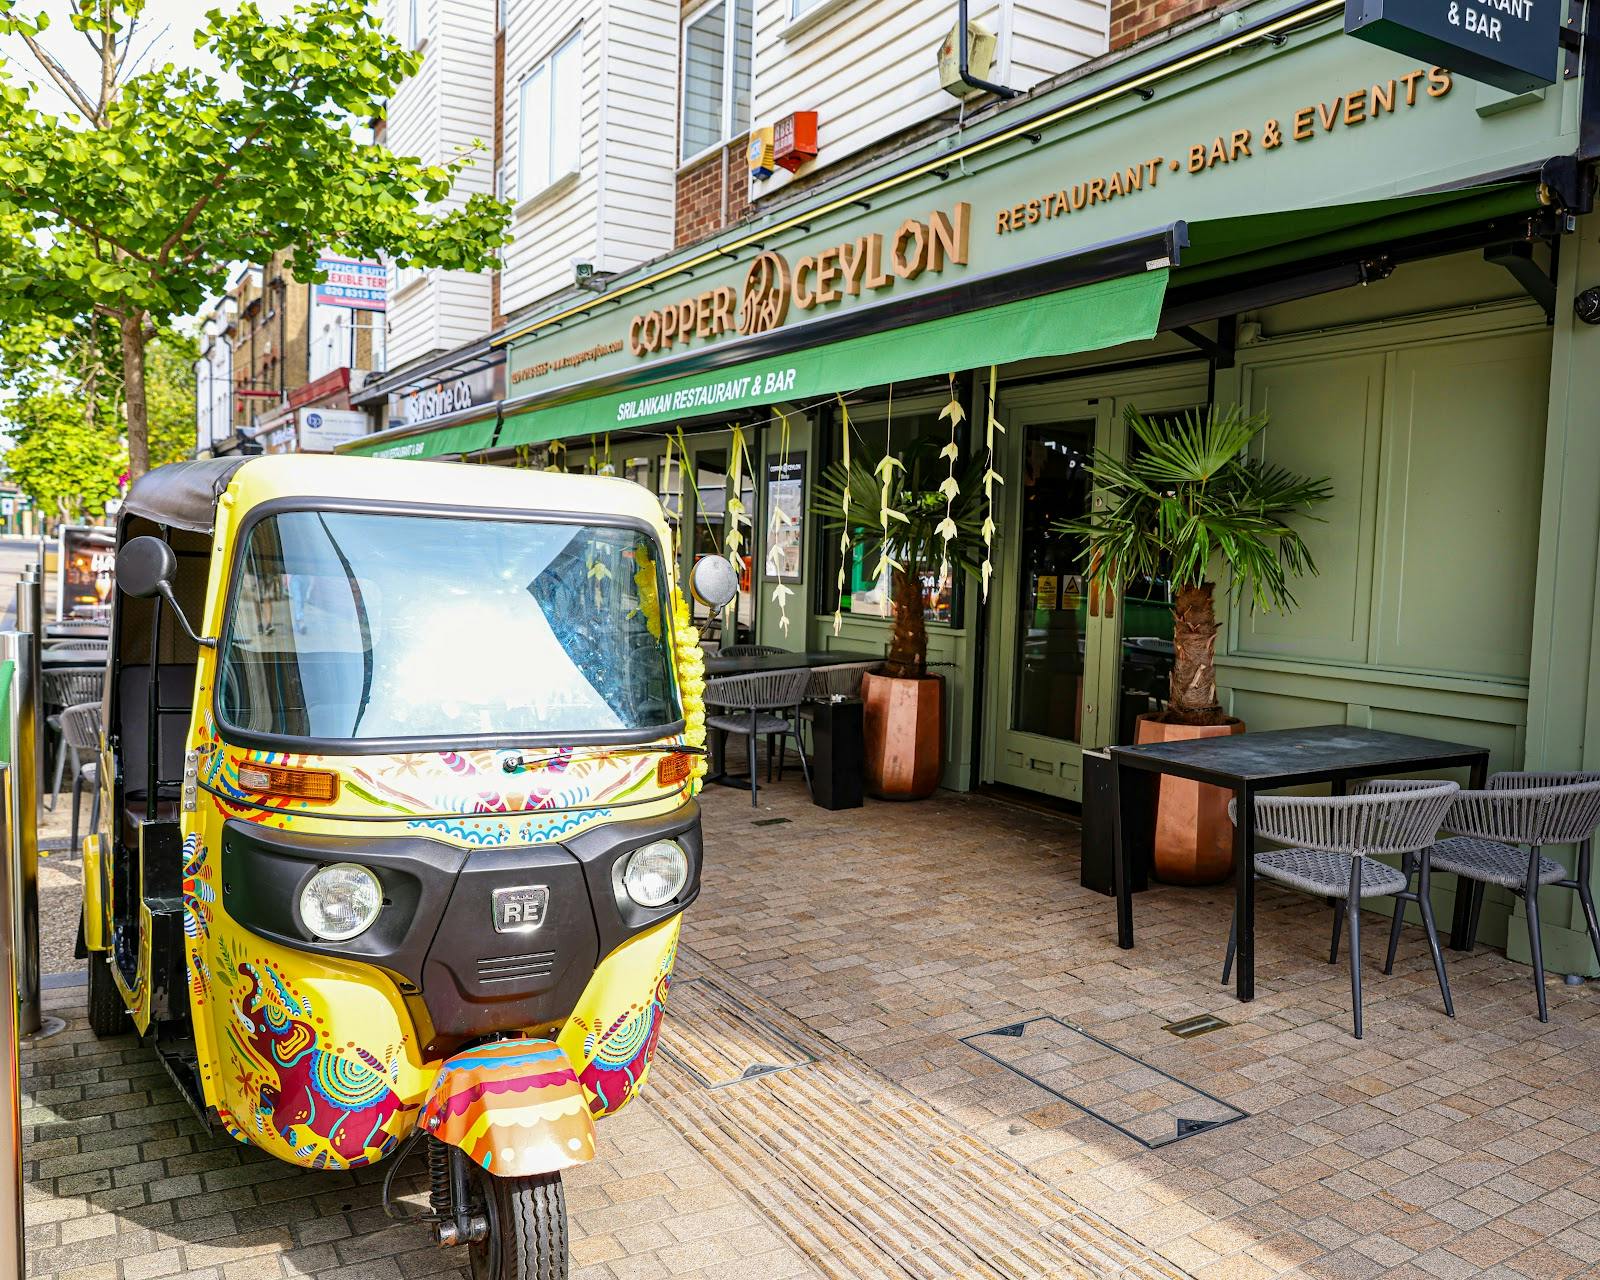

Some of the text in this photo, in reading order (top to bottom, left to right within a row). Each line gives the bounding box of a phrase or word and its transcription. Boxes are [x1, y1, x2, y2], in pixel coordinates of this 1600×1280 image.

[1447, 1, 1502, 42] & BAR
[995, 65, 1454, 234] RESTAURANT BAR & EVENTS
[361, 266, 386, 277] SUIT
[366, 276, 387, 288] TER
[628, 202, 972, 358] COPPER CEYLON
[616, 368, 796, 421] SRILANKAN RESTAURANT & BAR
[503, 900, 539, 923] RE
